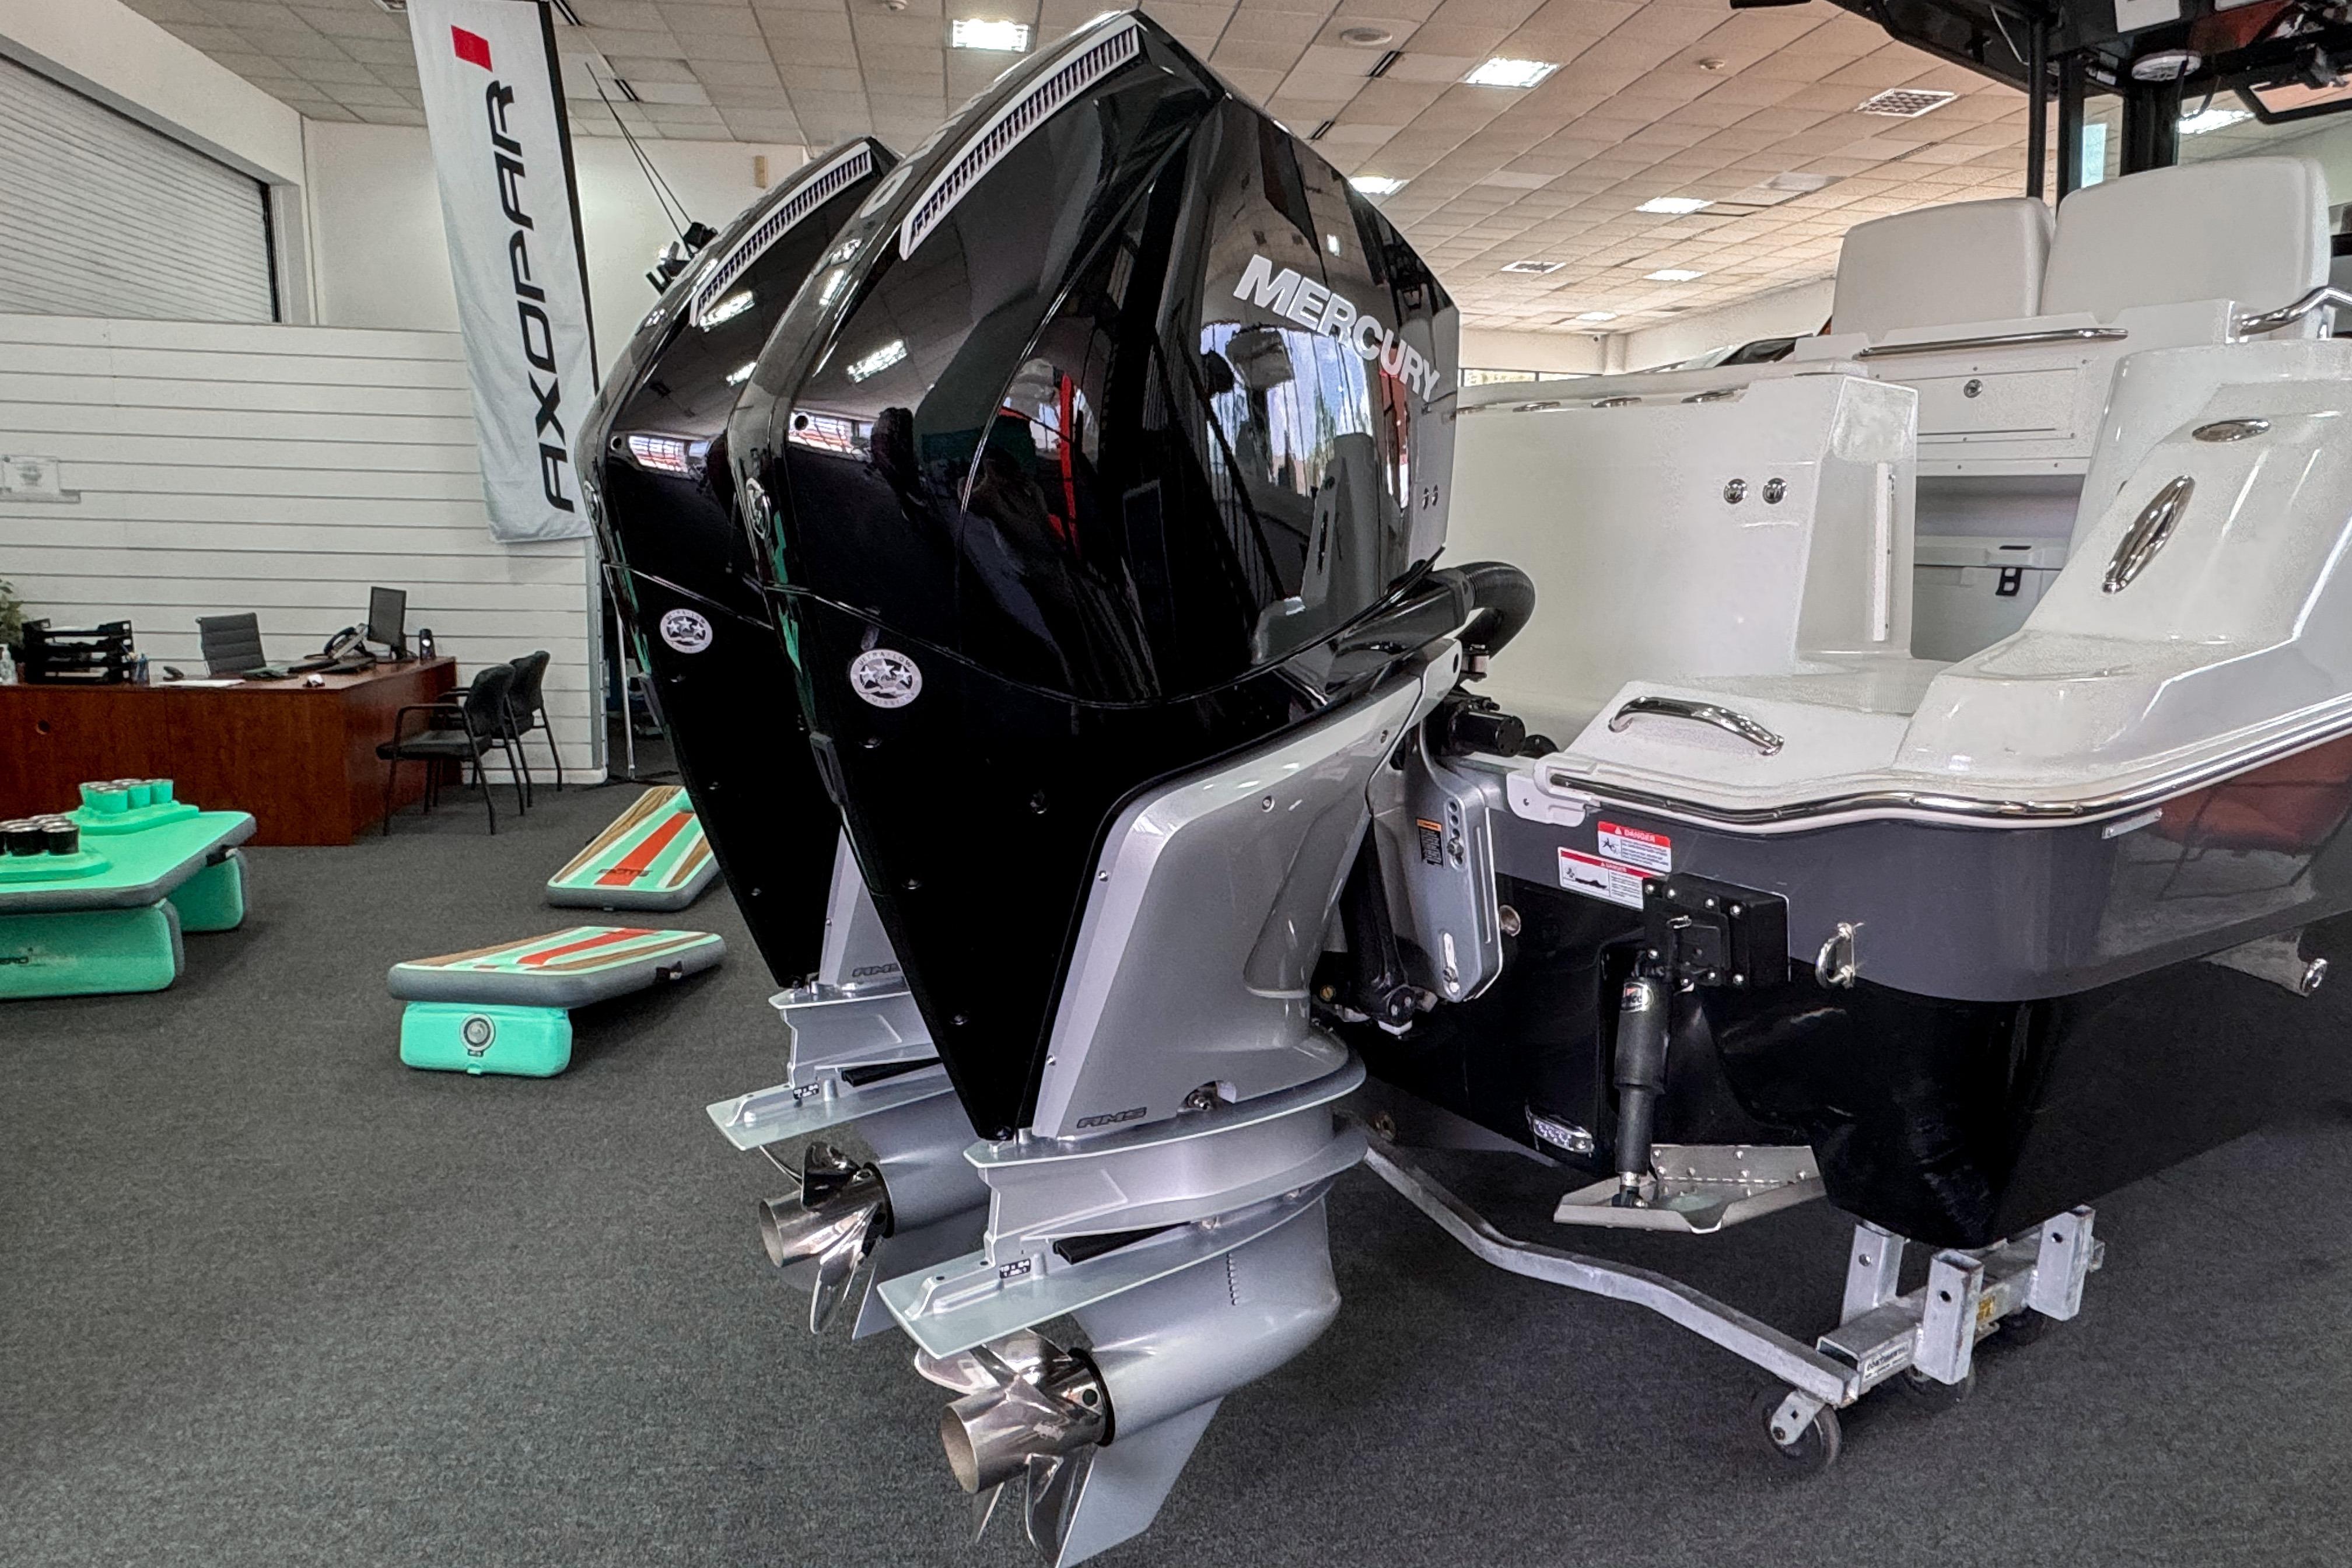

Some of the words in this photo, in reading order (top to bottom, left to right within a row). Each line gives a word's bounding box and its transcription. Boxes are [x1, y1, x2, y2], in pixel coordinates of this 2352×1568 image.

[485, 79, 575, 513] AXOPAR
[1233, 254, 1441, 402] MERCURY
[1076, 1107, 1147, 1129] AMS
